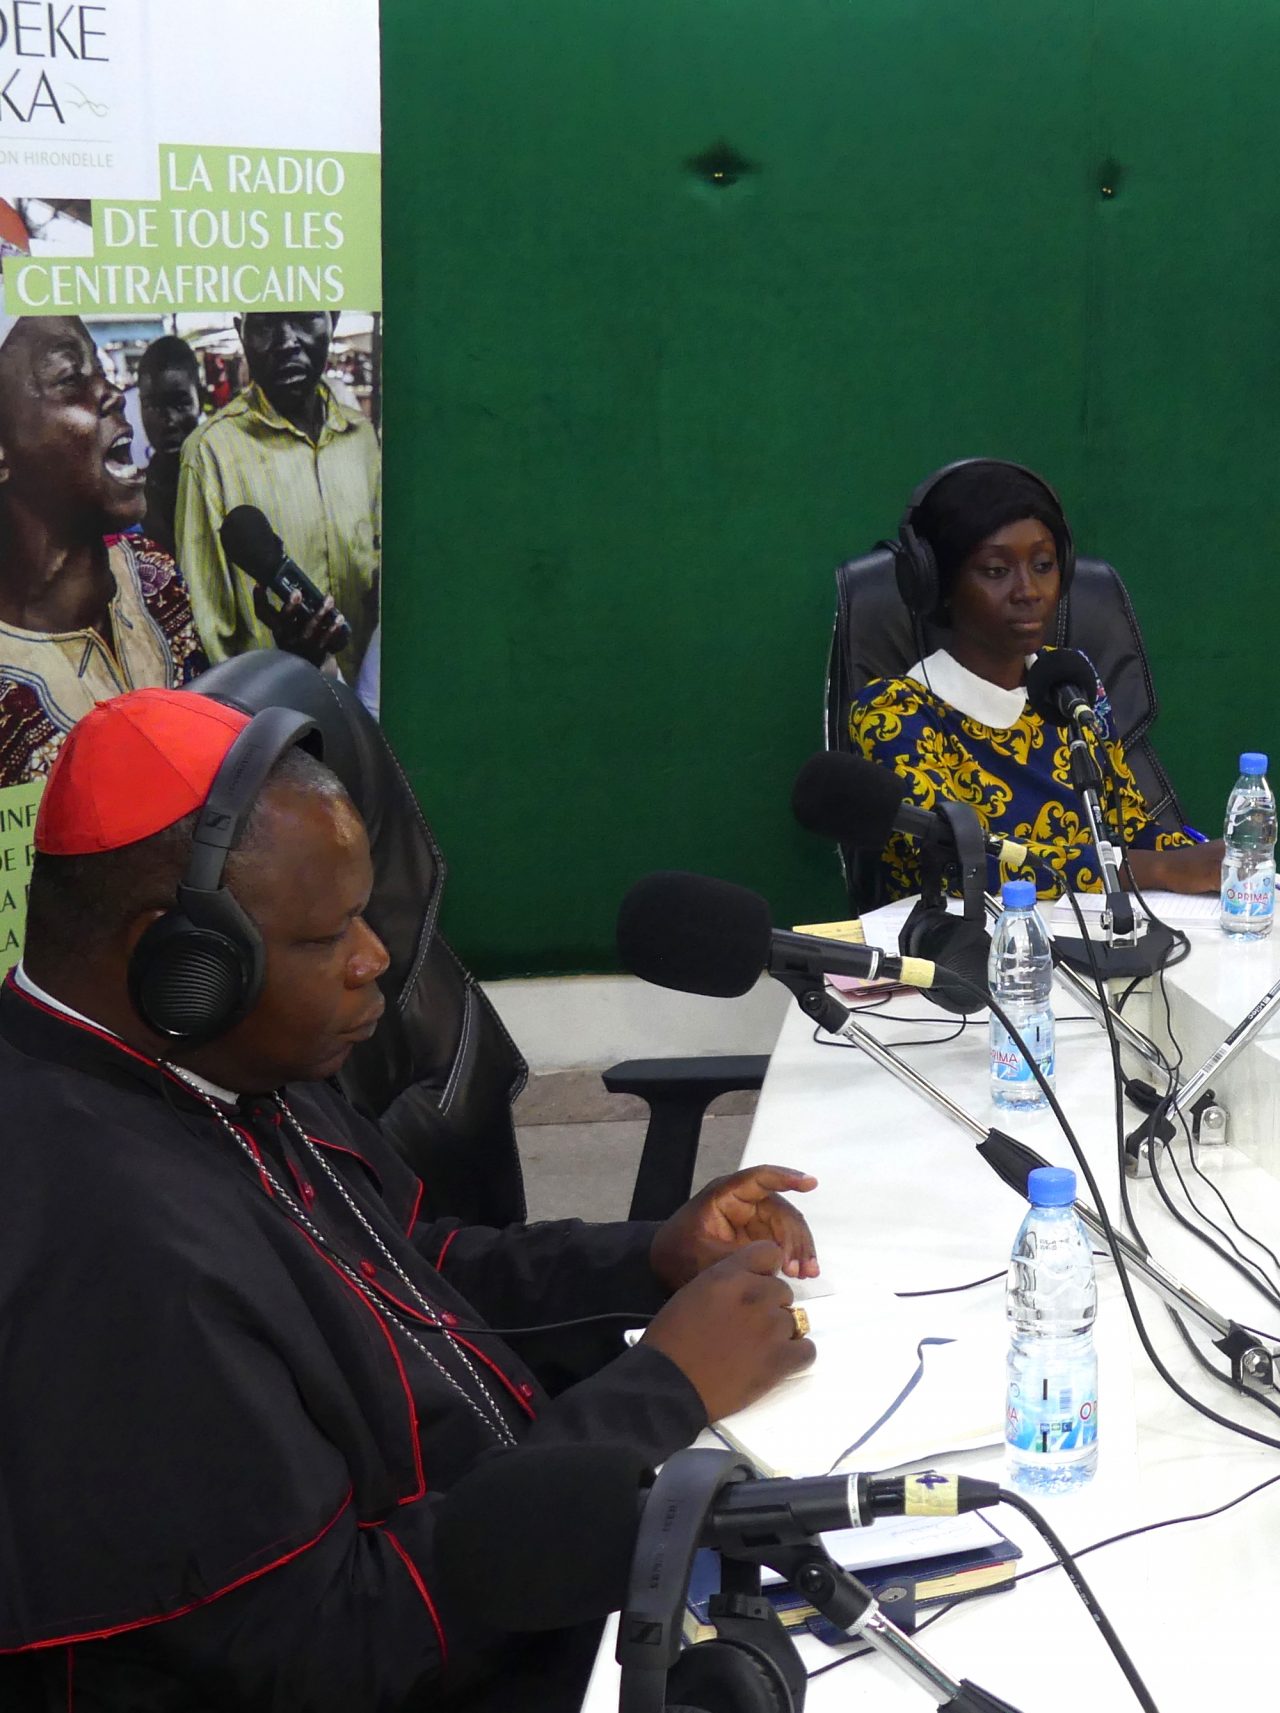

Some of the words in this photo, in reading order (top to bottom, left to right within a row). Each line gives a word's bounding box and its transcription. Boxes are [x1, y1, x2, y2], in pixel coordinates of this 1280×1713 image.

[24, 151, 114, 168] HIRONDELLE
[168, 152, 213, 193] LA
[228, 154, 345, 196] RADIO
[104, 208, 158, 248] DE
[170, 208, 270, 250] TOUS
[284, 211, 345, 250] LES
[16, 264, 345, 306] CENTRAFRICAINS
[1237, 892, 1269, 902] PRIMA
